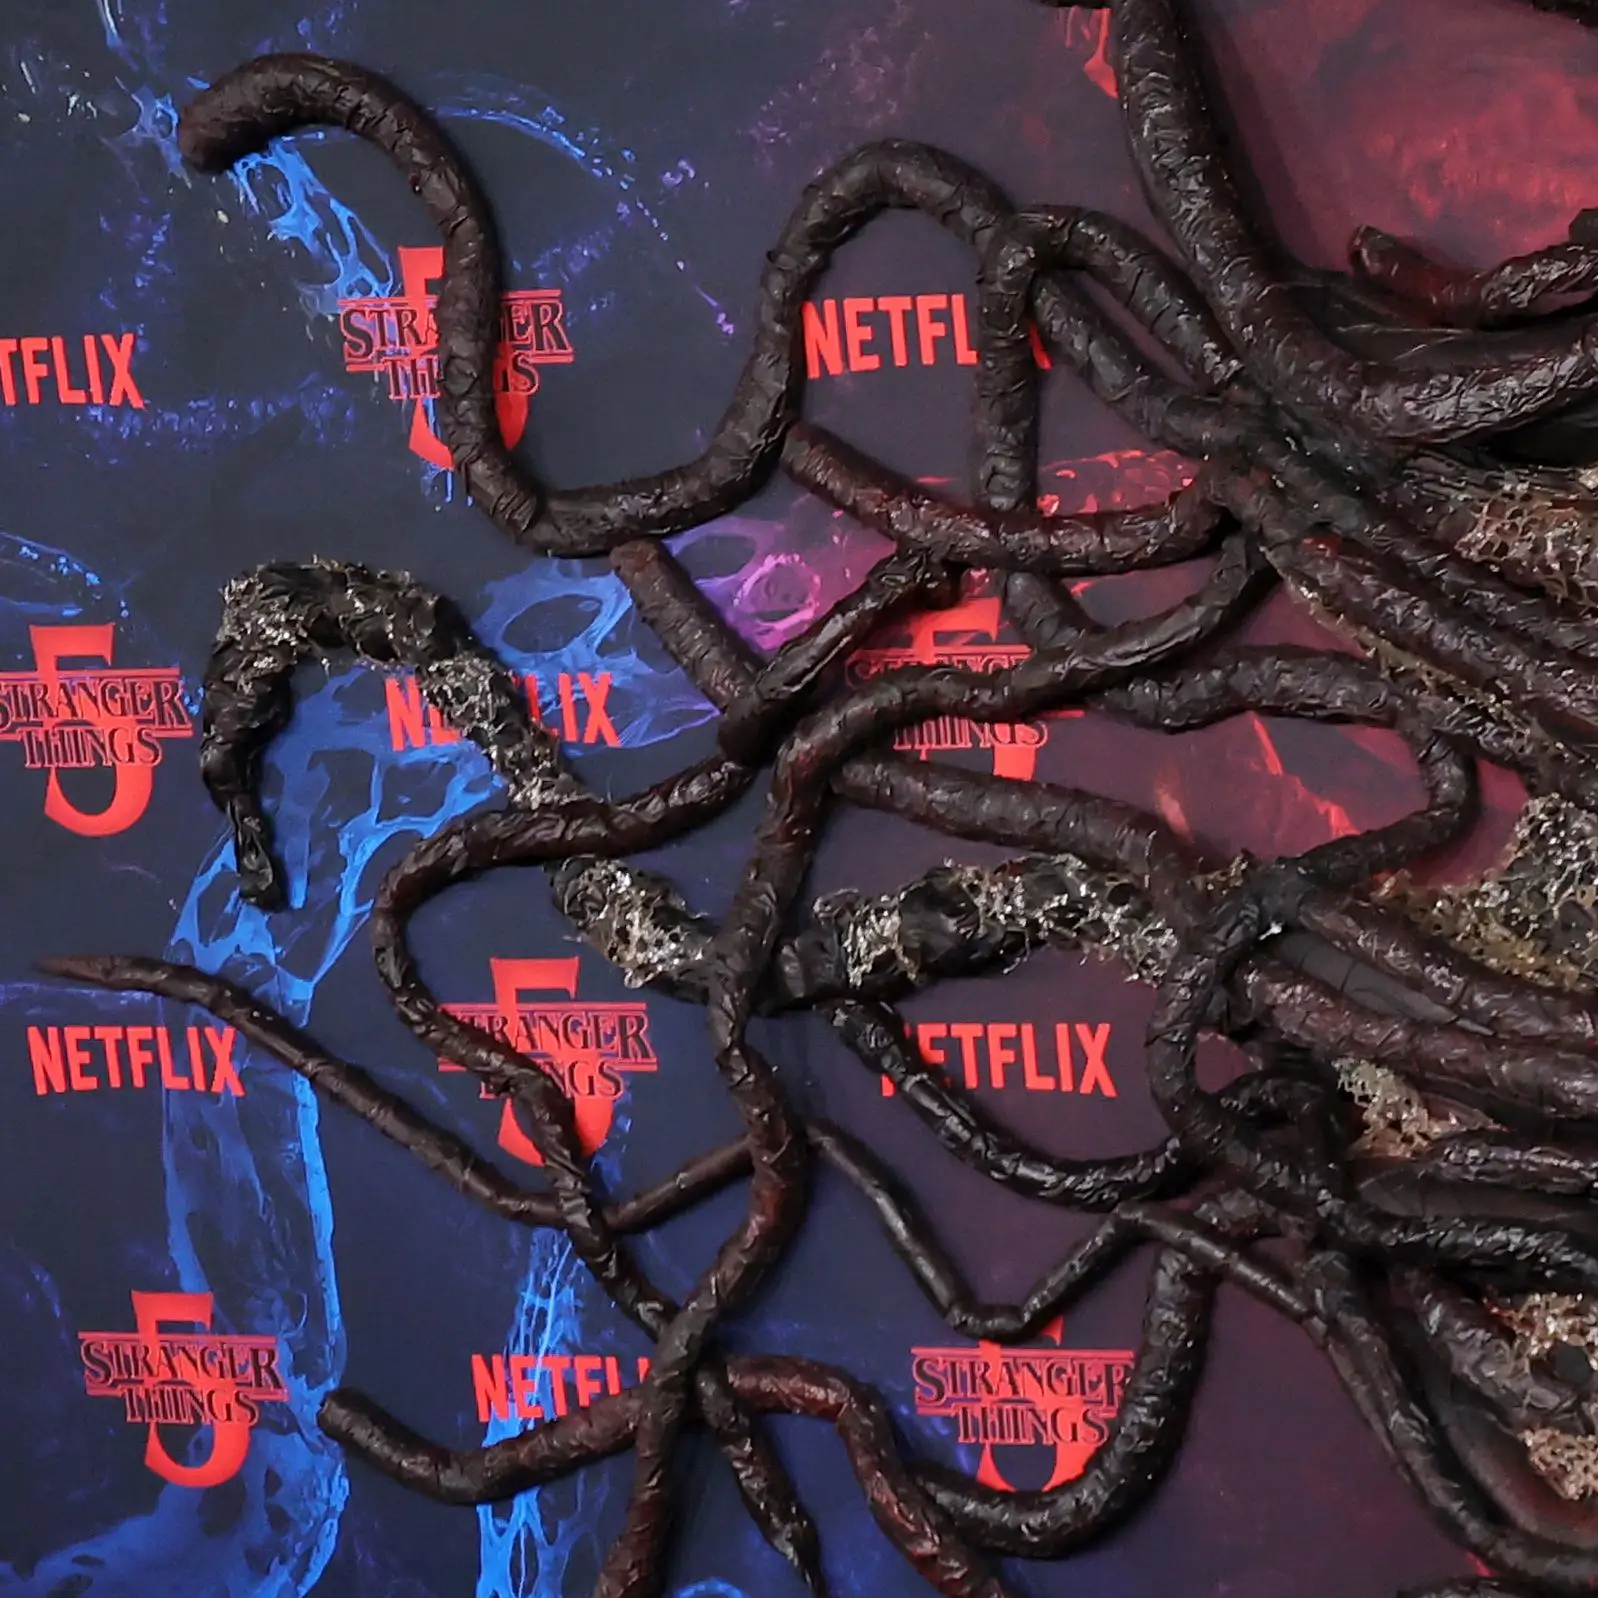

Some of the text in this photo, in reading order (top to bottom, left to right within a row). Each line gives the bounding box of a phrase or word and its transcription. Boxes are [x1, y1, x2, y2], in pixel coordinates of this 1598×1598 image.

[340, 301, 575, 362] STRER
[802, 294, 1052, 379] NETFL
[381, 350, 541, 399] THS
[29, 622, 155, 837] 5
[385, 672, 622, 752] NLIX
[18, 724, 163, 768] THINGS
[27, 1025, 245, 1096] NETFLIX
[455, 1010, 657, 1060] RANGER
[881, 1022, 1118, 1098] ETFLIX
[80, 1340, 288, 1391] STRANGER
[130, 1288, 252, 1489] 5
[120, 1384, 260, 1427] THINGS
[952, 1400, 1111, 1447] THINGS
